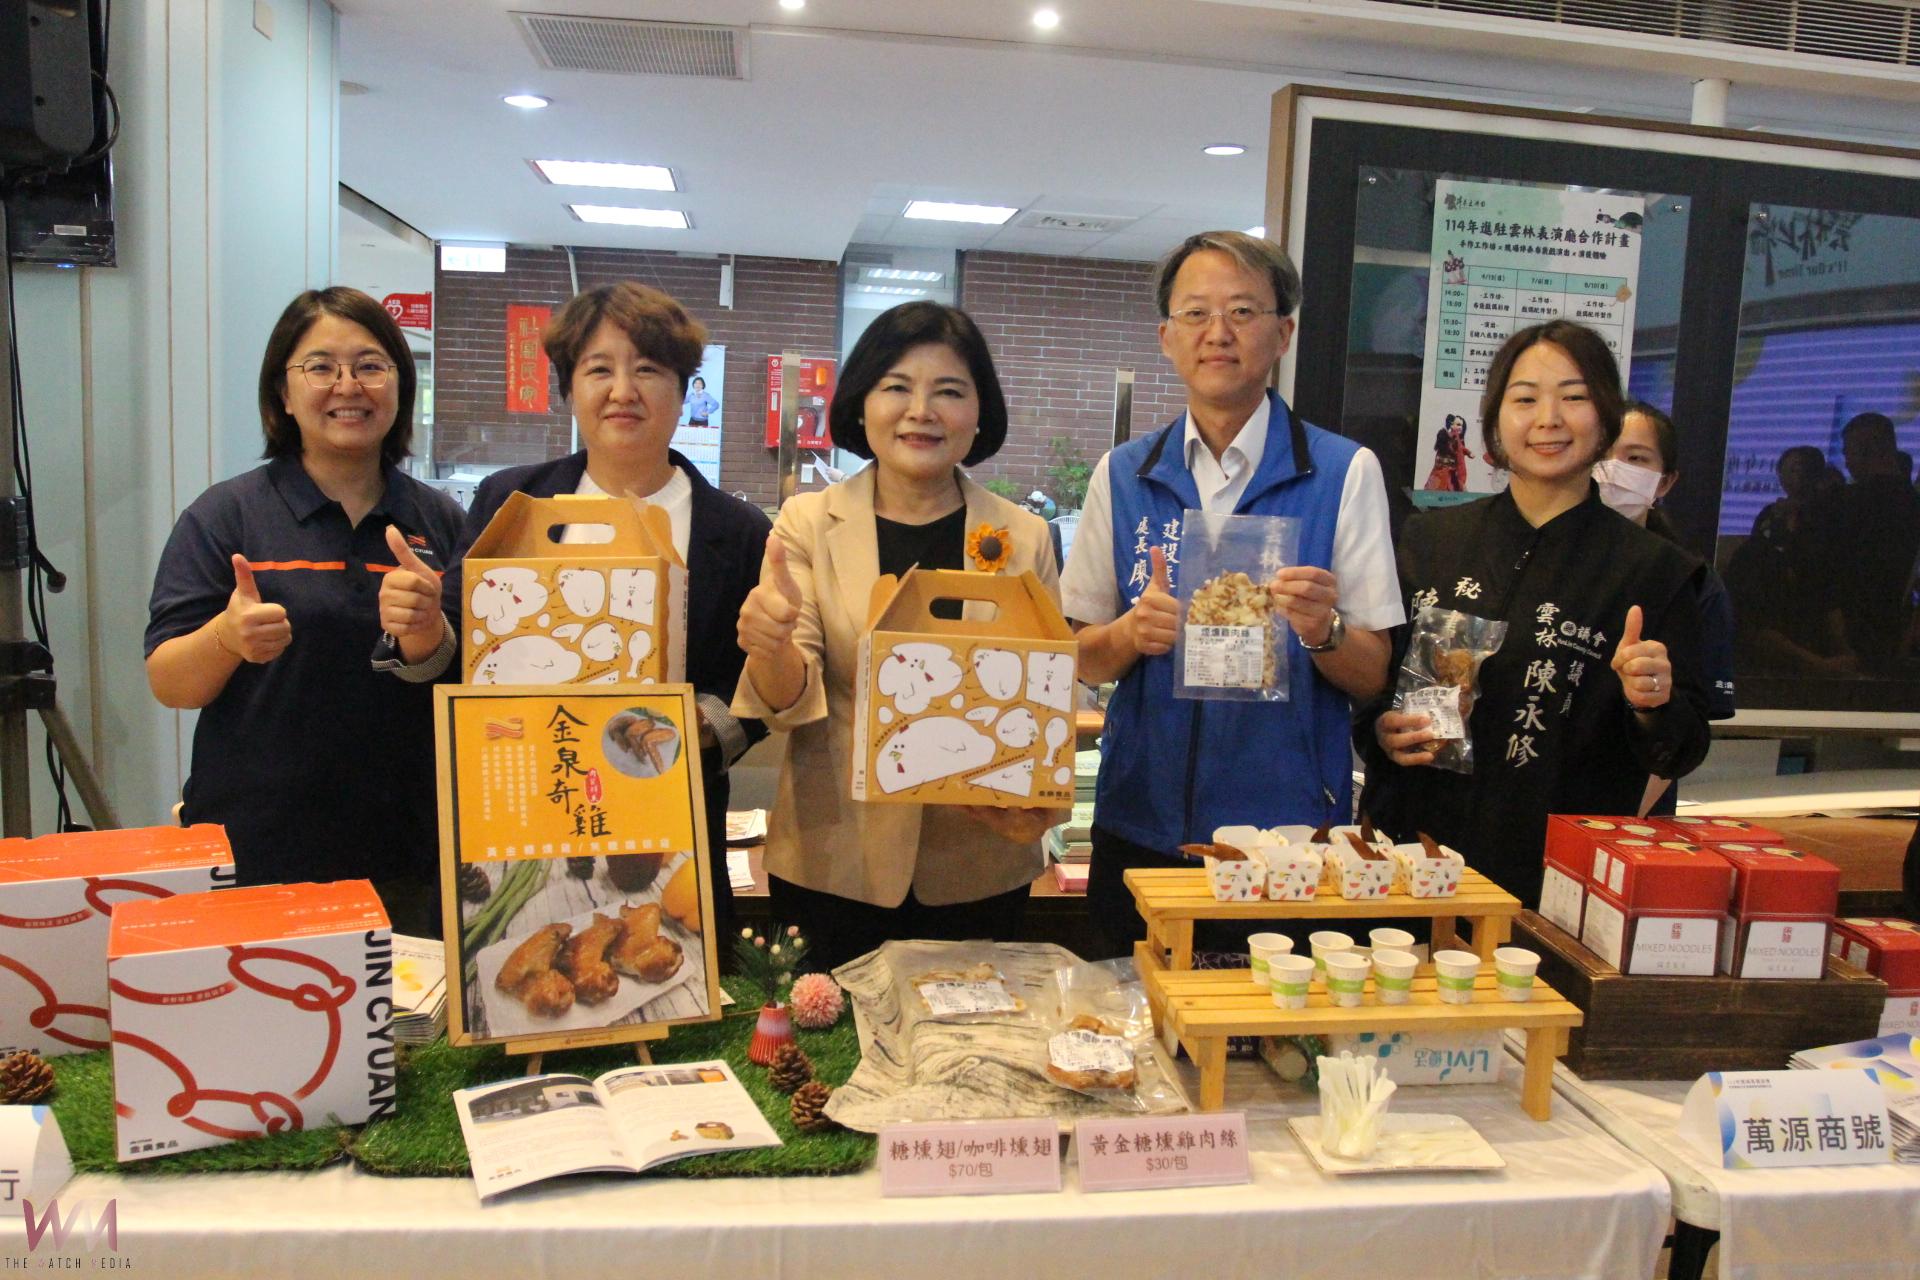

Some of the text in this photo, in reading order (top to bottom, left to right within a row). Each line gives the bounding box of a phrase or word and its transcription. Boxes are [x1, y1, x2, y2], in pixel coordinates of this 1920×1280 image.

[1445, 219, 1630, 248] 114年進駐雲林表演廳合作計畫
[1535, 602, 1560, 648] 雲林
[1505, 659, 1558, 769] 陳永修
[546, 704, 612, 838] 金泉奇雞
[1636, 943, 1713, 954] MIXED NOODLES
[364, 929, 397, 1123] JIN CYUAN
[888, 1135, 1053, 1161] 糖燻翅/咖啡燻翅
[1090, 1129, 1239, 1157] 黃金糖燻雞肉絲
[1742, 1113, 1885, 1154] 萬源商號
[948, 1161, 993, 1178] $70/包
[1146, 1155, 1189, 1172] $30/包
